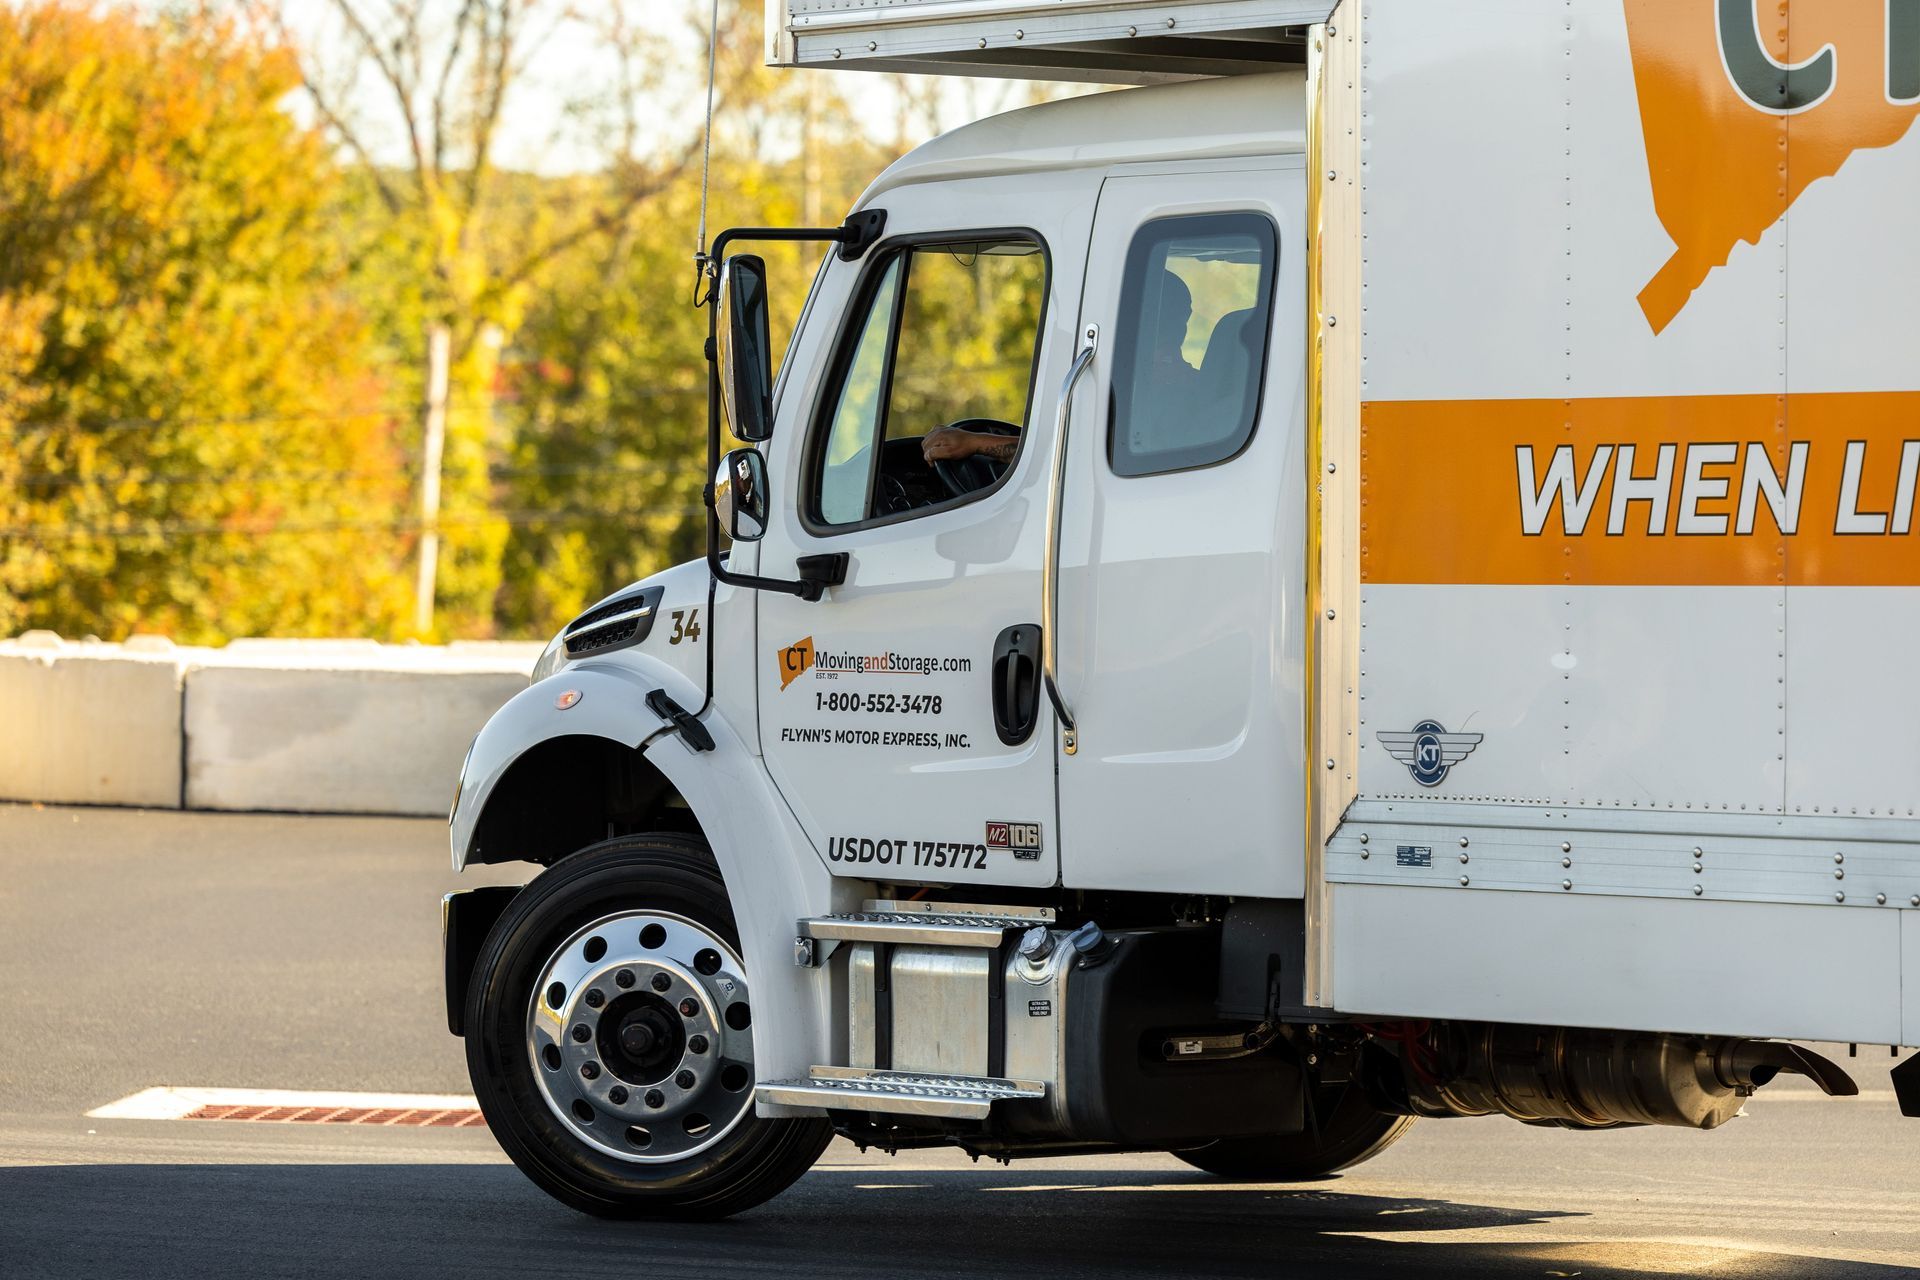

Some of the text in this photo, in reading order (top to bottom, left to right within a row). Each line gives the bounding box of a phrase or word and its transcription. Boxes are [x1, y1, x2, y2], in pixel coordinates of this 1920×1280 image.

[1514, 440, 1811, 537] WHEN
[669, 608, 701, 645] 34
[786, 647, 971, 675] CT MovingandStorage.com
[816, 692, 942, 714] 1-800-552-3478
[781, 728, 971, 750] FLYNN'S MOTOR EXPRESS, INC.
[1418, 744, 1440, 761] KT
[989, 824, 1038, 847] M2 106
[829, 837, 987, 870] USDOT 175772
